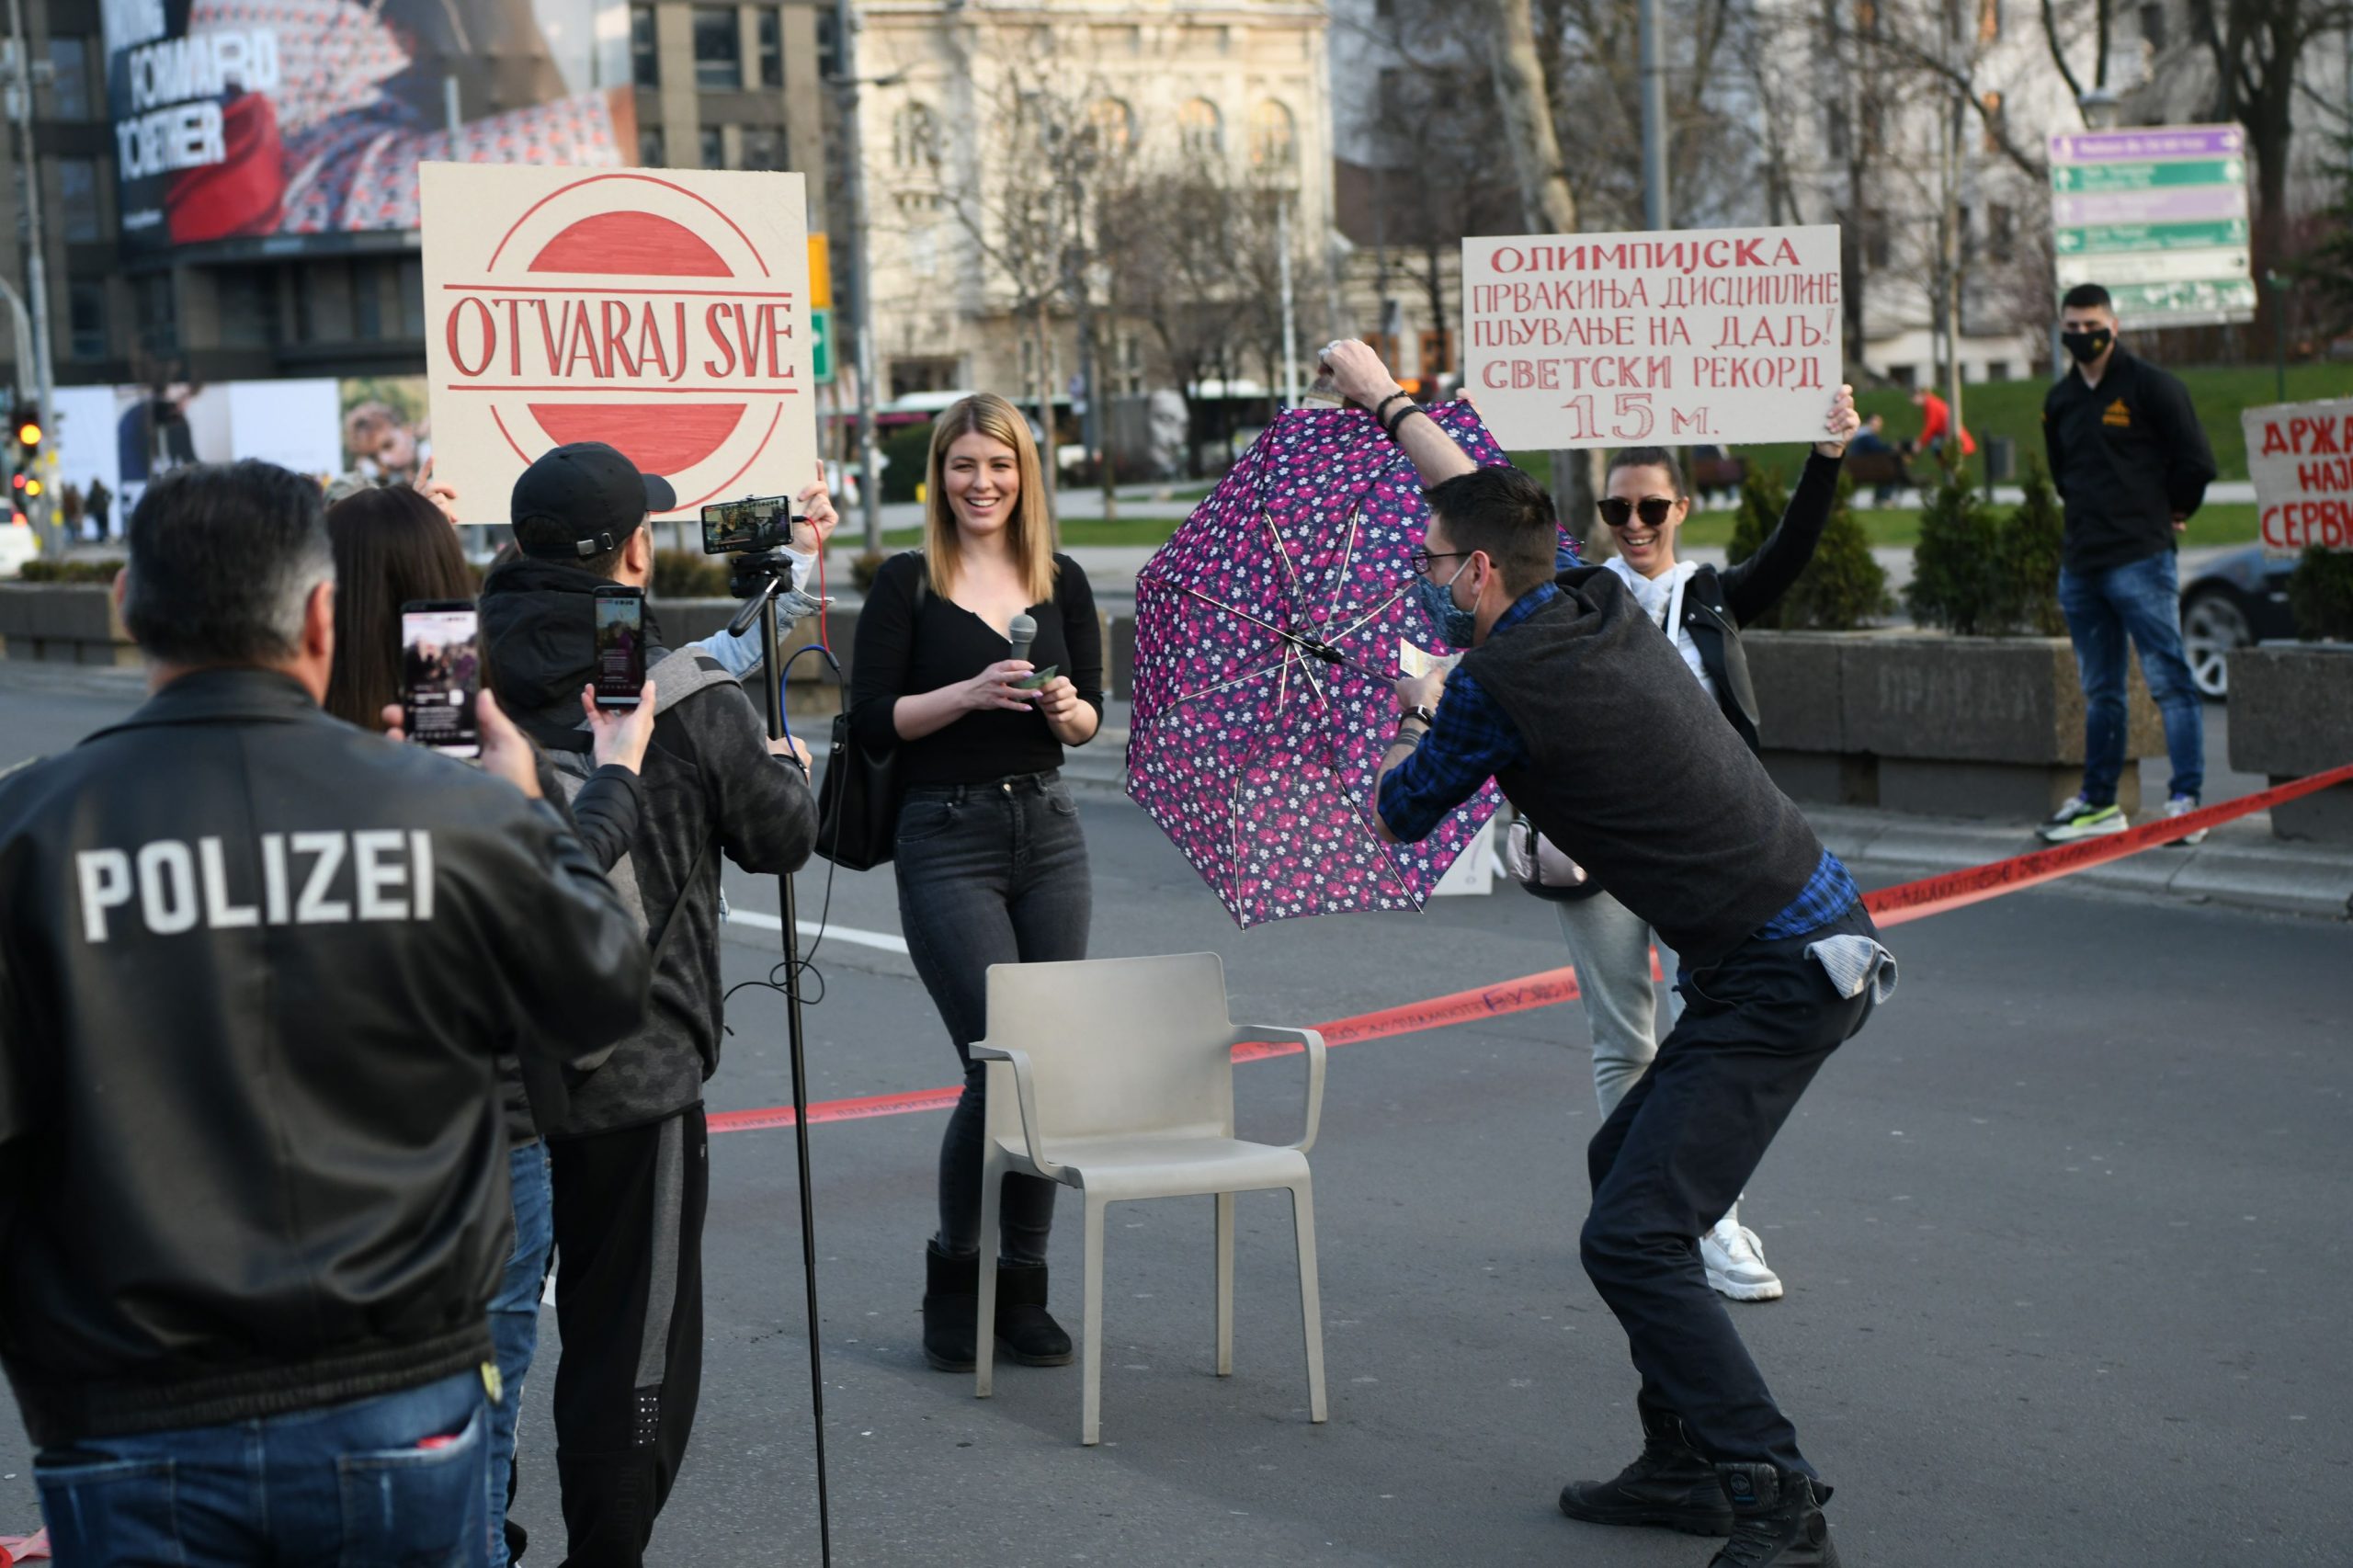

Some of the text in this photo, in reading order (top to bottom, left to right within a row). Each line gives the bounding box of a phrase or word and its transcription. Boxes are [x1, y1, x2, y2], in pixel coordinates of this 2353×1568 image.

[1491, 237, 1802, 275] ОЛИМПИЈСКА
[1473, 272, 1838, 313] ПРВАКИЊА ДИСЦИПЛИНЕ
[446, 297, 794, 382] OTVARAJ SVE
[1473, 307, 1836, 350] ПЉУВАЊЕ НА ДАЉ!
[1482, 355, 1824, 392] СВЕТСКИ РЕКОРД
[1561, 392, 1654, 440] 15
[2299, 457, 2353, 493] НАЈ
[75, 828, 435, 943] POLIZEI
